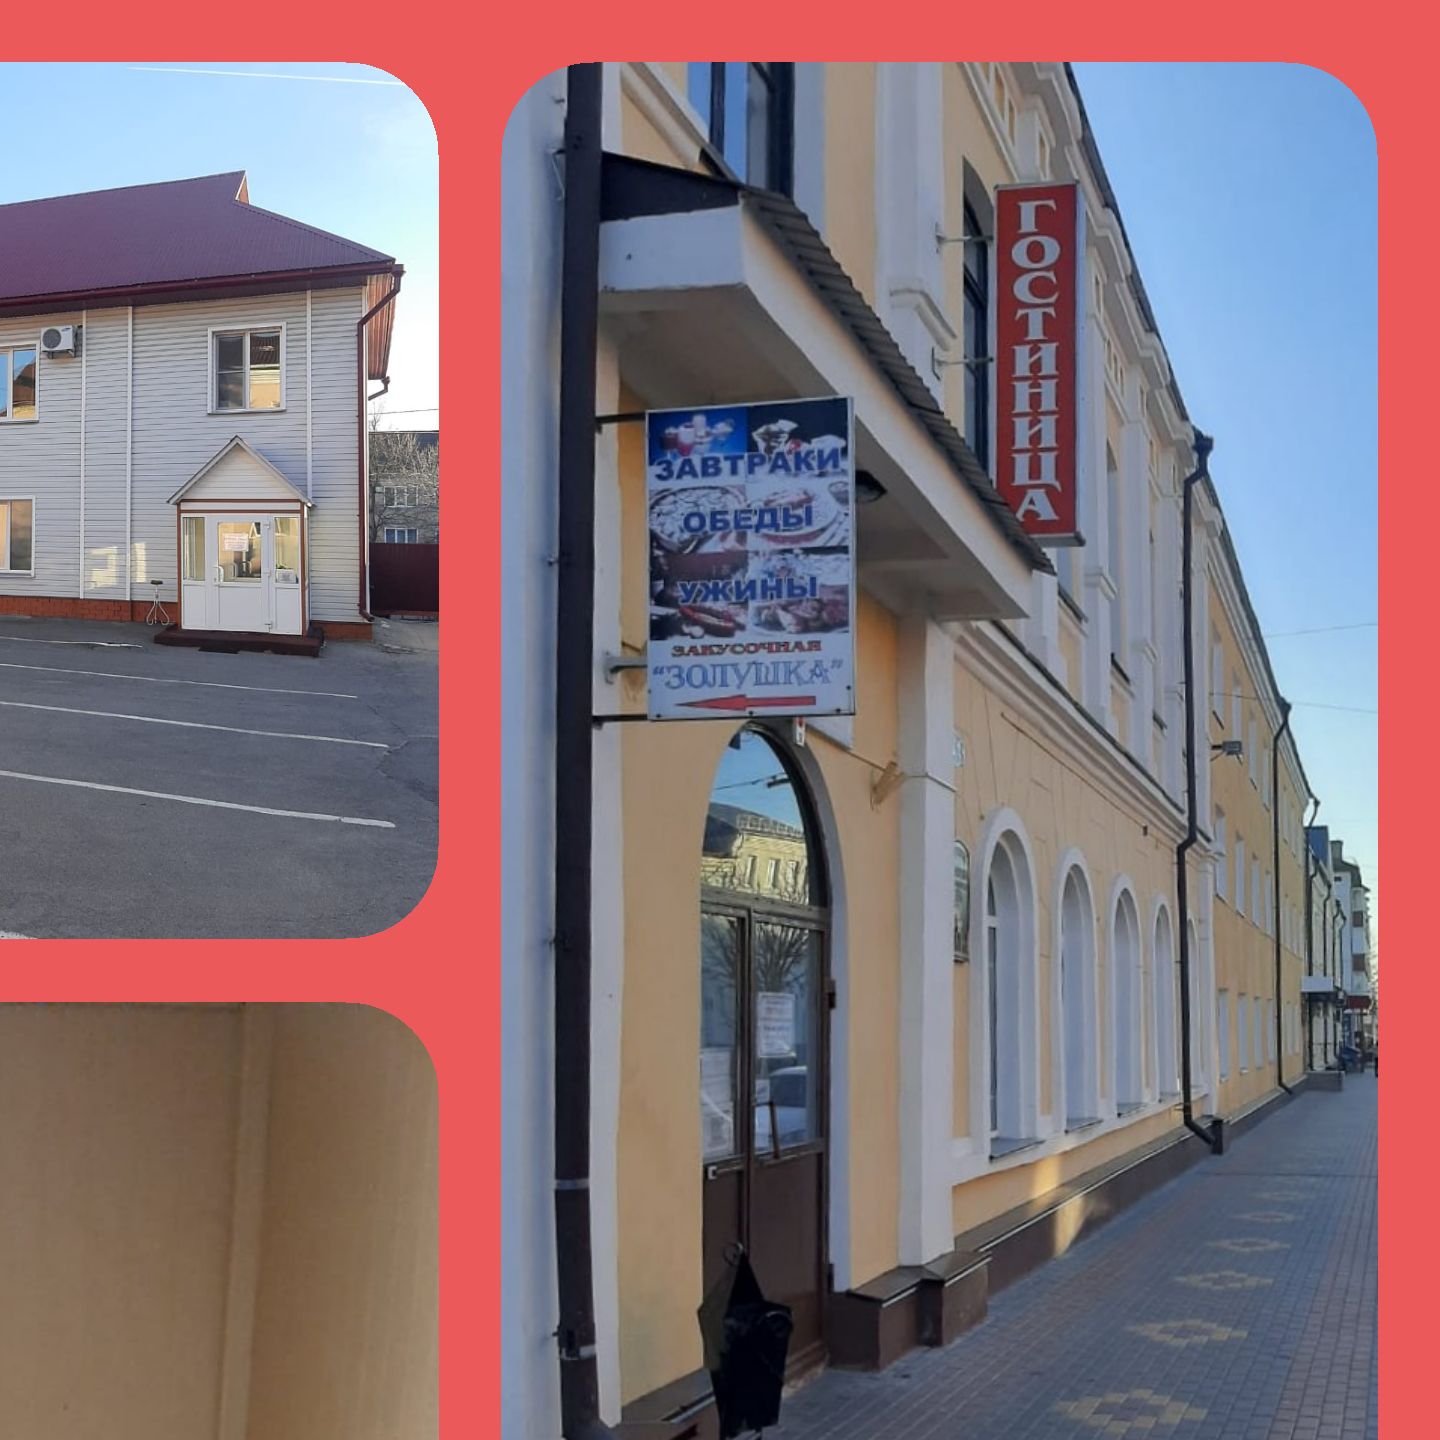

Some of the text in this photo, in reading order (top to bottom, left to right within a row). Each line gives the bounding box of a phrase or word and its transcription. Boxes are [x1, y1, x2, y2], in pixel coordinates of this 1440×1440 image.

[1011, 199, 1062, 521] ГОСТИНИЦА
[655, 447, 841, 481] ЗАВТРАКИ
[682, 506, 812, 534] ОБЕДЫ
[677, 576, 817, 604] УЖИНЫ
[671, 639, 822, 657] ЗАКУСОЧНАЯ
